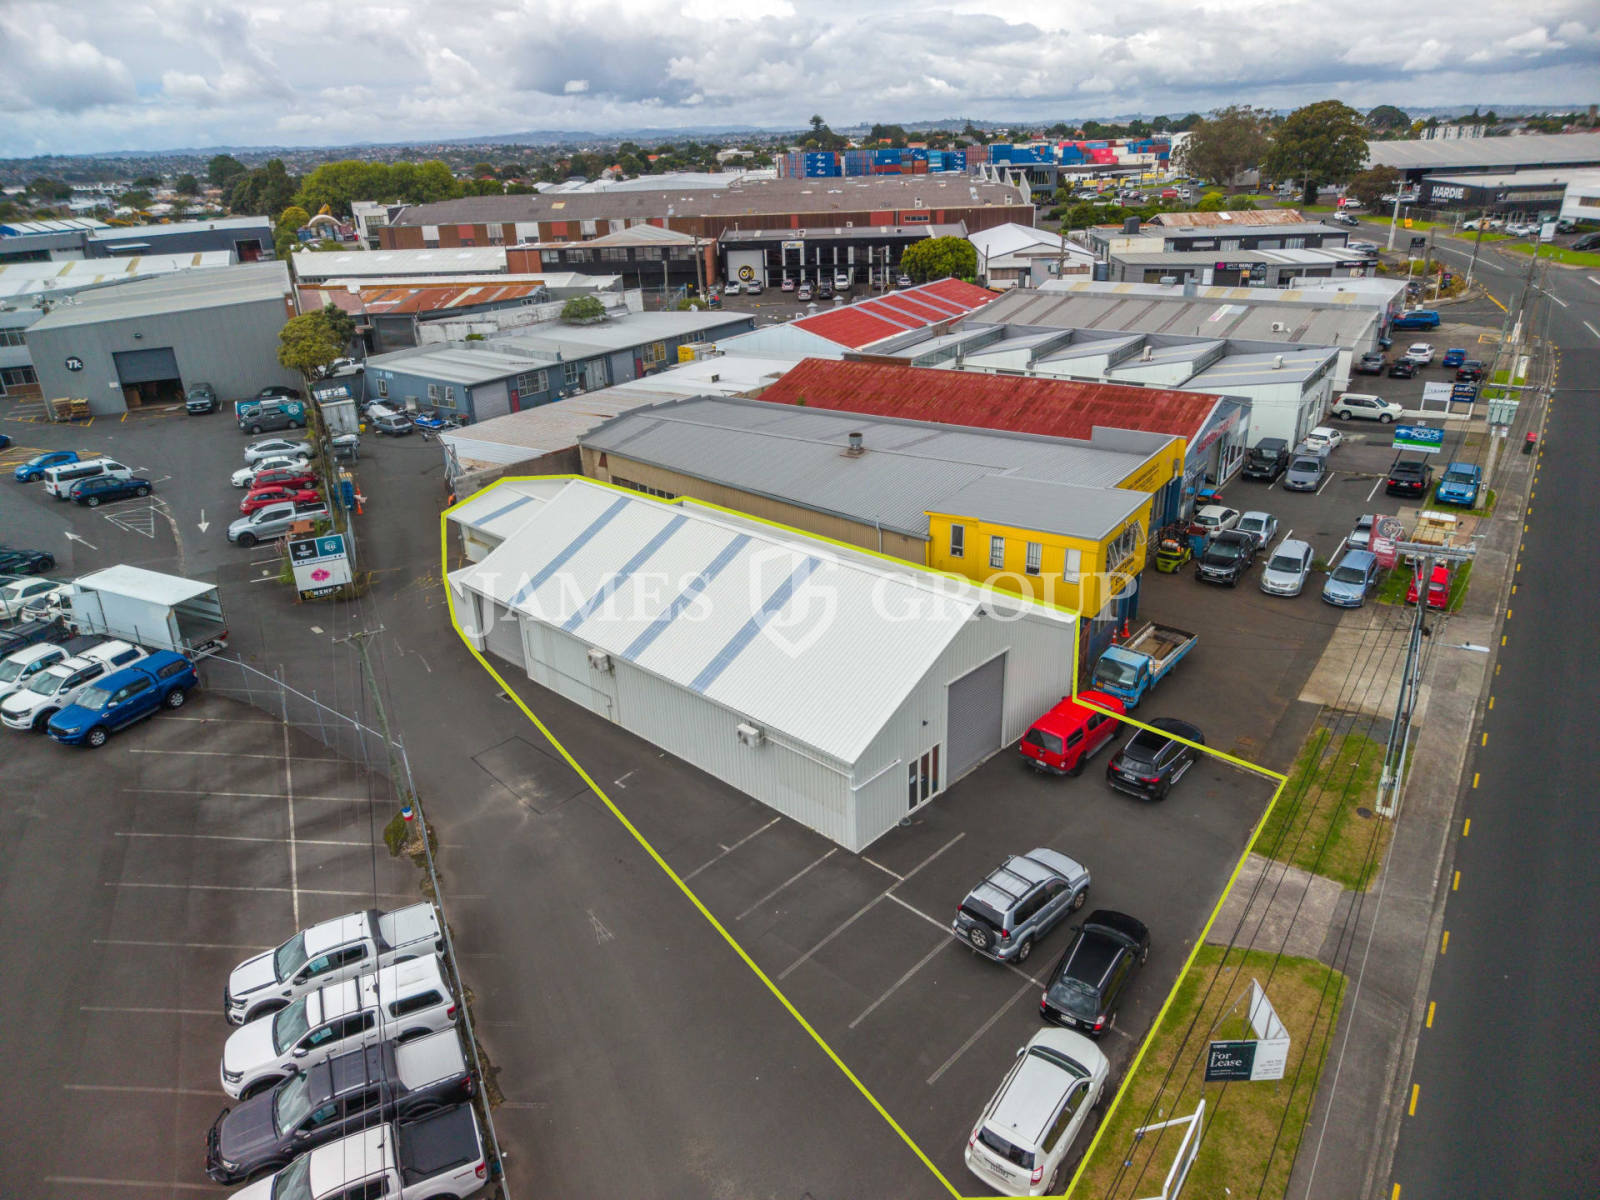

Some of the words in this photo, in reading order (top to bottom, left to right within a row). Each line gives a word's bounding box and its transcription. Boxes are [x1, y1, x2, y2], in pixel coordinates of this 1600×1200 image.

[1431, 185, 1464, 199] HARDIE
[1211, 1051, 1232, 1060] For
[1210, 1058, 1243, 1068] Lease
